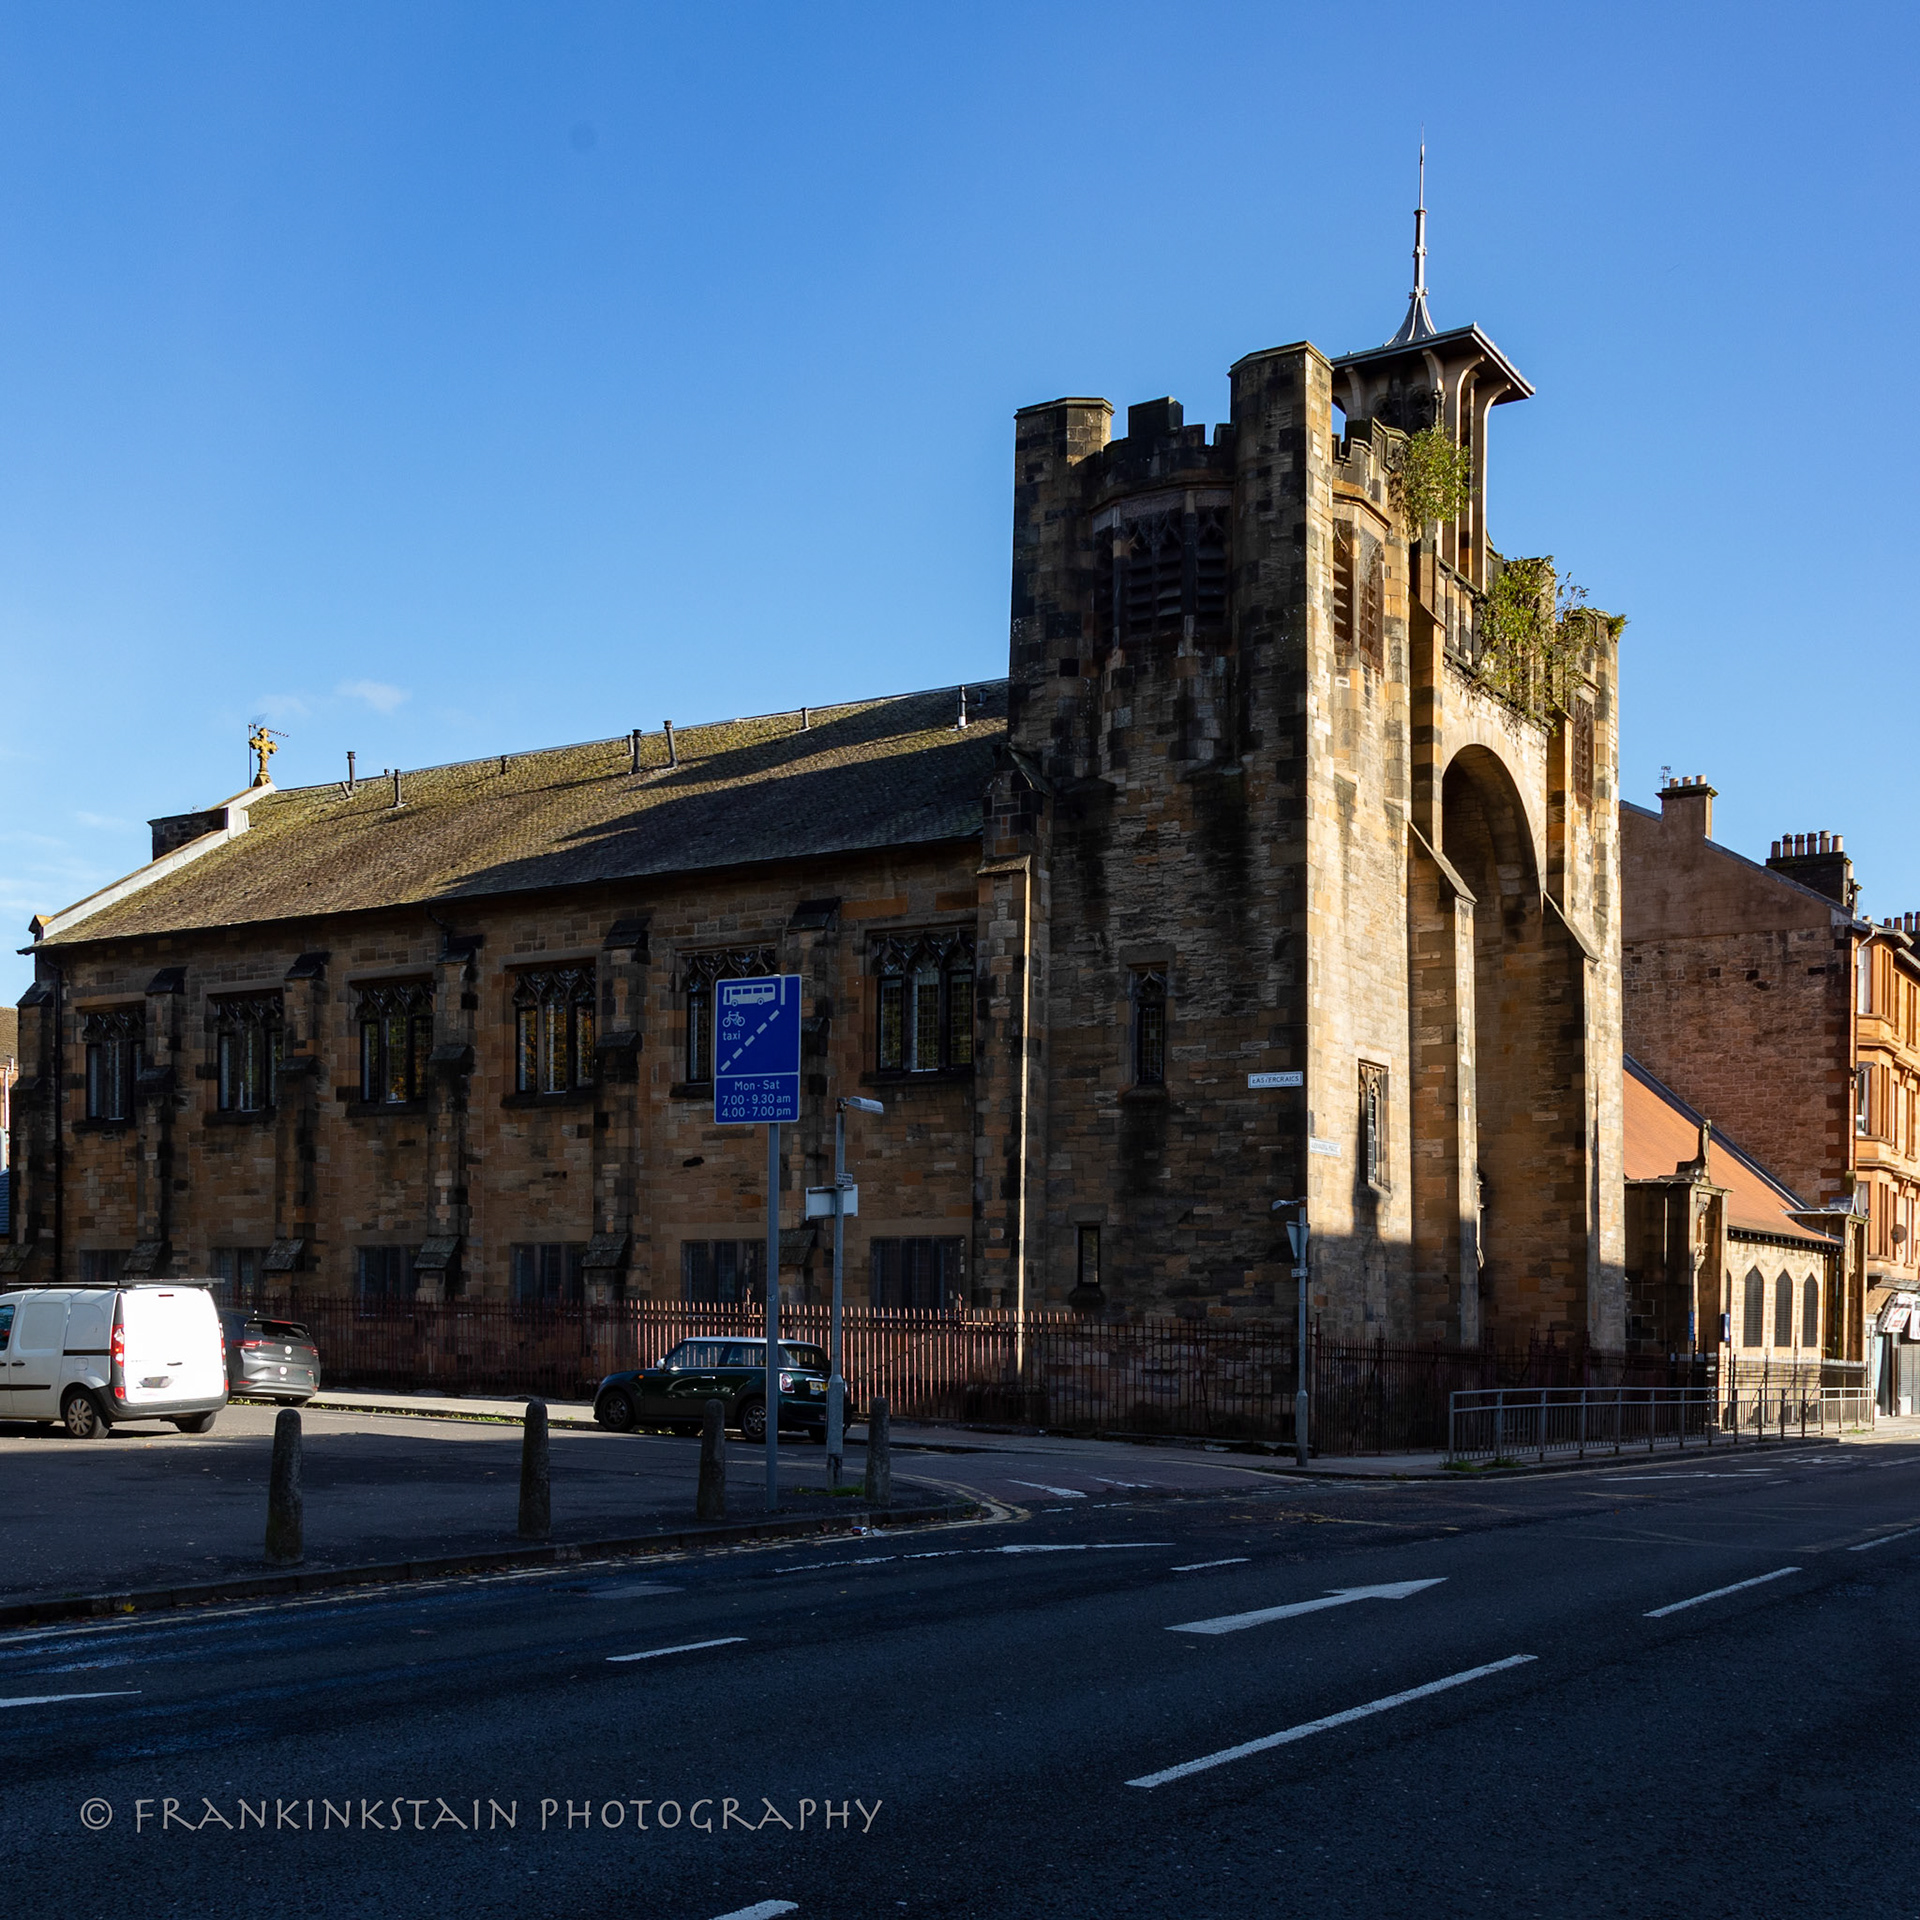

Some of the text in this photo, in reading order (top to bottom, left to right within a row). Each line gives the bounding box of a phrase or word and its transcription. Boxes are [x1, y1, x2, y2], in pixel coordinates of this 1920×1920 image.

[722, 1030, 741, 1041] taxi
[734, 1081, 756, 1091] Mon
[763, 1080, 780, 1090] Sat
[722, 1095, 745, 1105] 7.00
[752, 1093, 775, 1104] 9.30
[776, 1095, 791, 1103] am
[721, 1107, 745, 1118] 4.00
[752, 1106, 775, 1117] 7.00
[776, 1107, 791, 1117] pm
